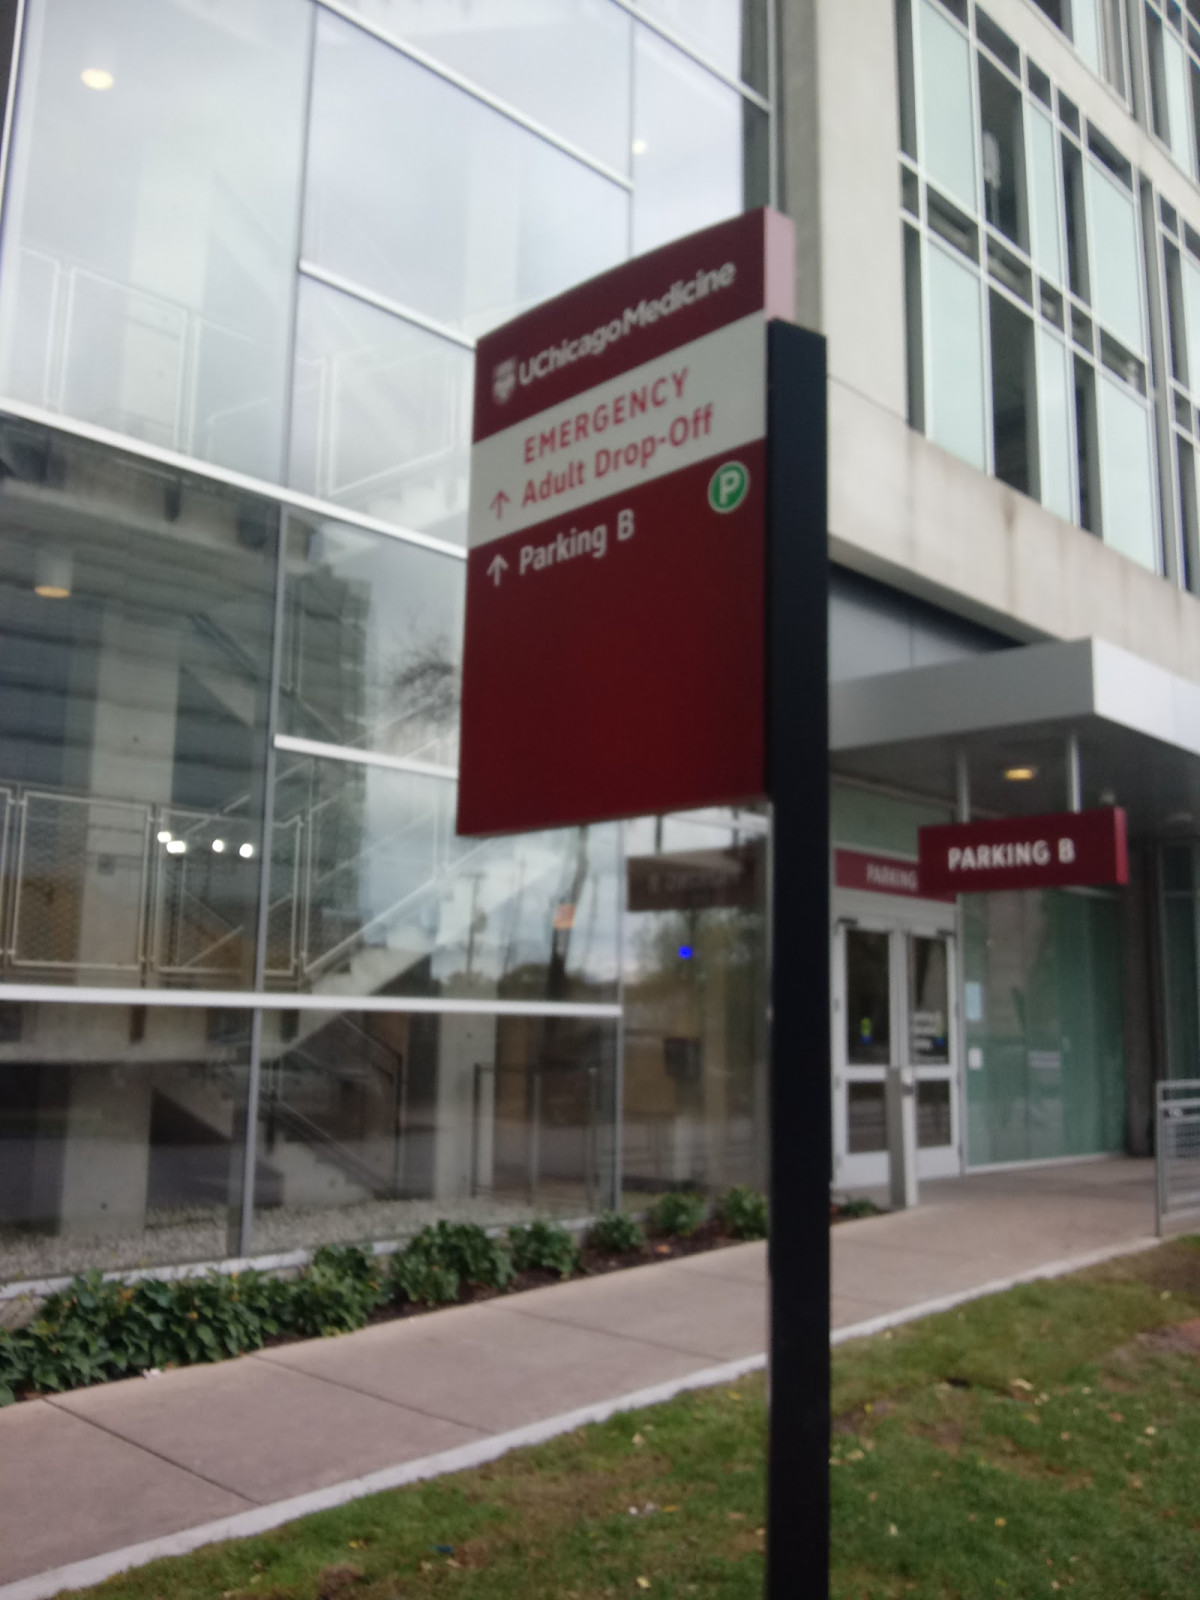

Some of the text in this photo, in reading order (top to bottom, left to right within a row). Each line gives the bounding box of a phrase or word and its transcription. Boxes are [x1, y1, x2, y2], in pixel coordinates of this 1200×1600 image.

[523, 367, 690, 464] EMERGENCY
[521, 403, 714, 508] Adult Drop-Off
[519, 508, 635, 576] Parking B
[866, 862, 917, 890] PARKING
[948, 837, 1075, 871] PARKING B
